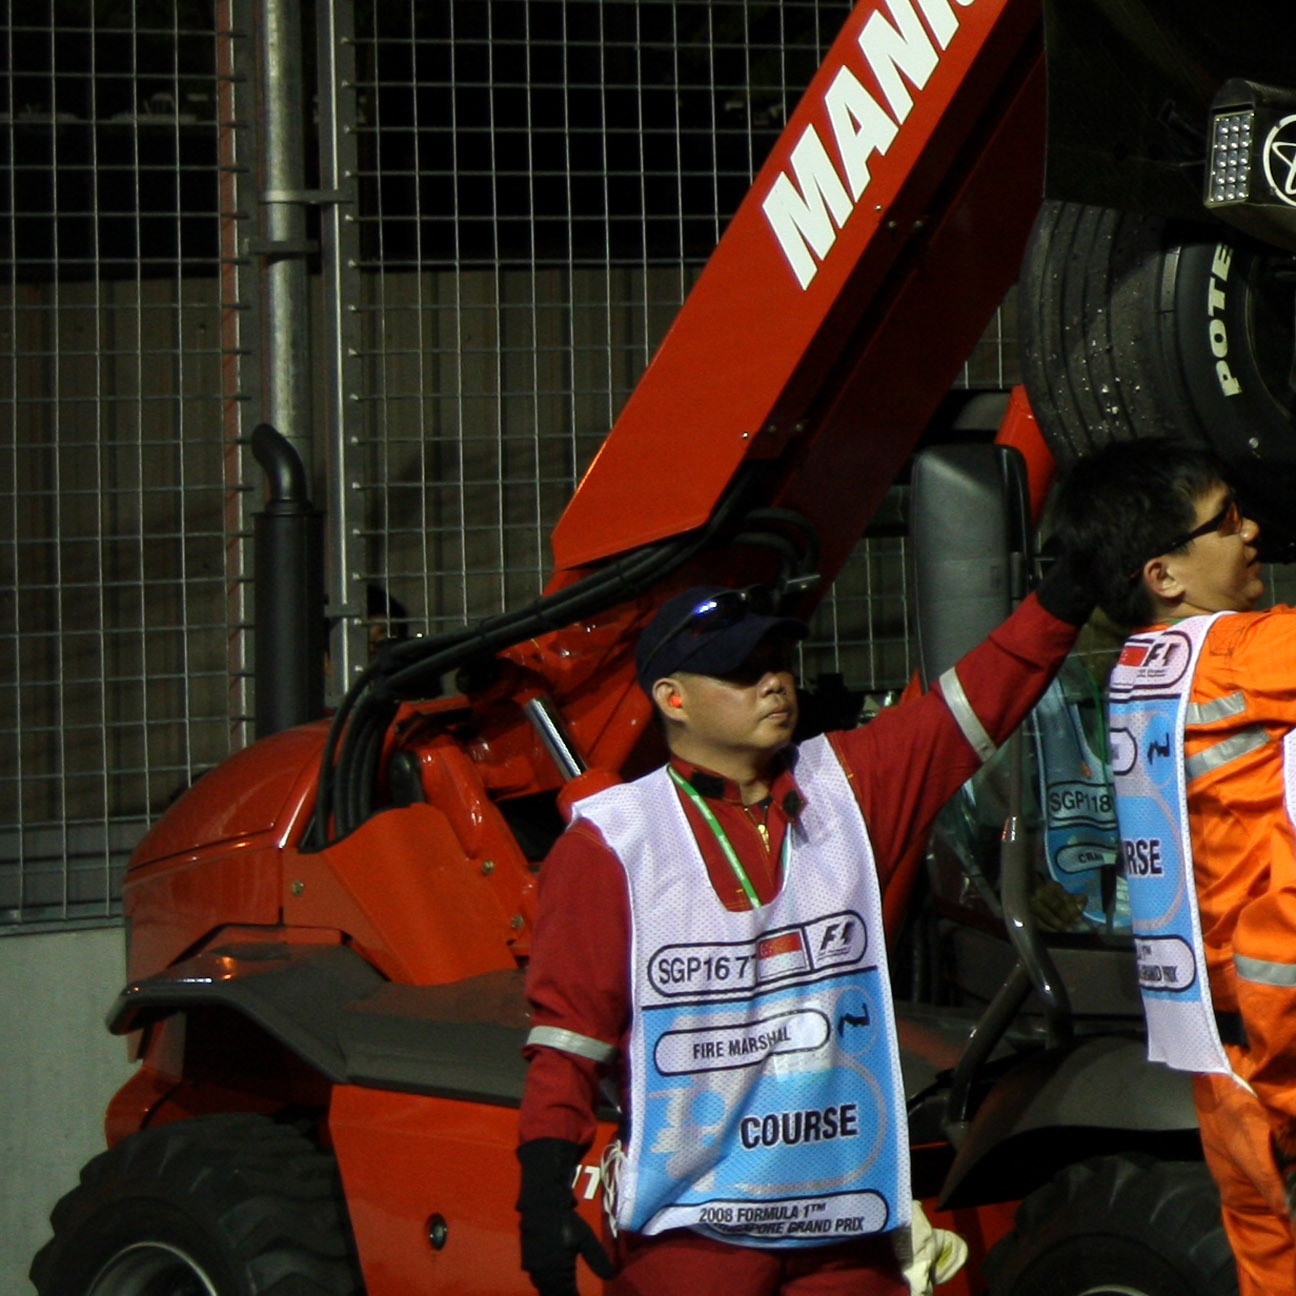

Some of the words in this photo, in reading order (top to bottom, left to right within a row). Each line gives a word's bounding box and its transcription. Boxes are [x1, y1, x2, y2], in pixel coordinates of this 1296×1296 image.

[658, 954, 757, 985] SGP167
[693, 1041, 724, 1060] FIRE
[729, 1027, 792, 1056] MARSHAL
[740, 1104, 858, 1149] COURSE
[699, 1207, 733, 1222] 2008
[737, 1205, 798, 1223] FORMULA
[787, 1219, 832, 1234] GRAND
[835, 1216, 865, 1231] PRIX
